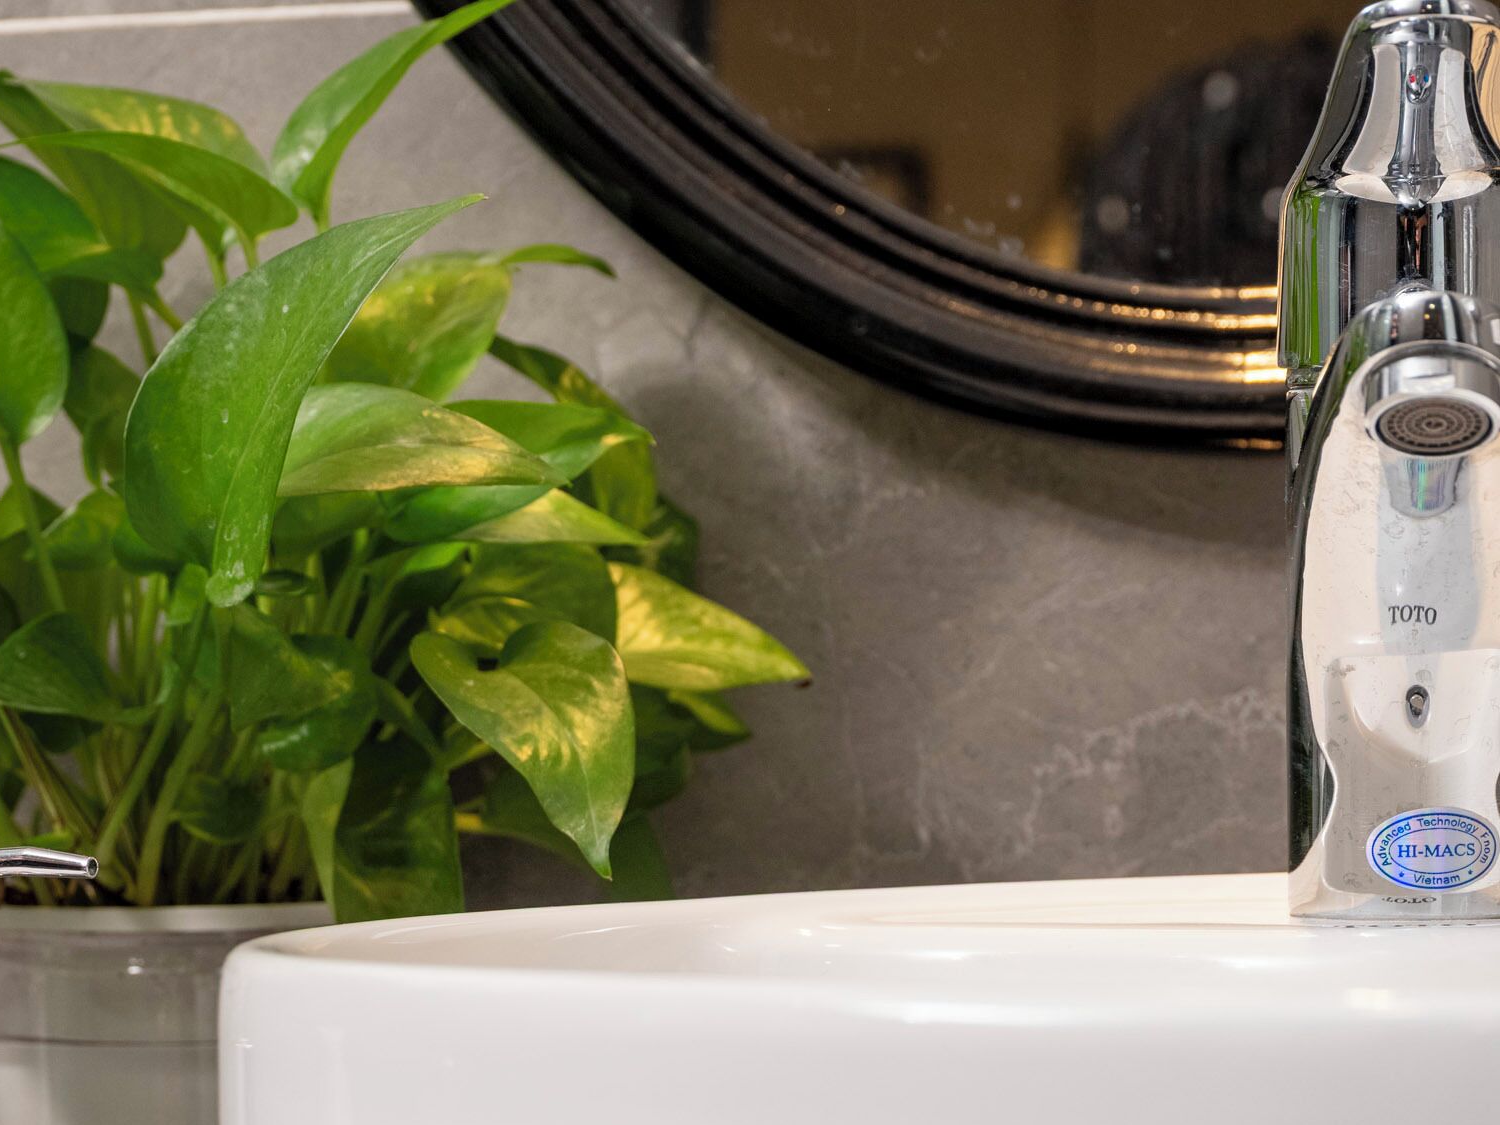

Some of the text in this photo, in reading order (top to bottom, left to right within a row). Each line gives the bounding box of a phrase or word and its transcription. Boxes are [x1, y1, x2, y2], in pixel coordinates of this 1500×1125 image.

[1387, 604, 1438, 625] TOTO
[1377, 821, 1412, 867] Advanced
[1416, 817, 1480, 834] Technology
[1397, 842, 1476, 858] HI-MACS
[1413, 873, 1461, 886] Vietnam
